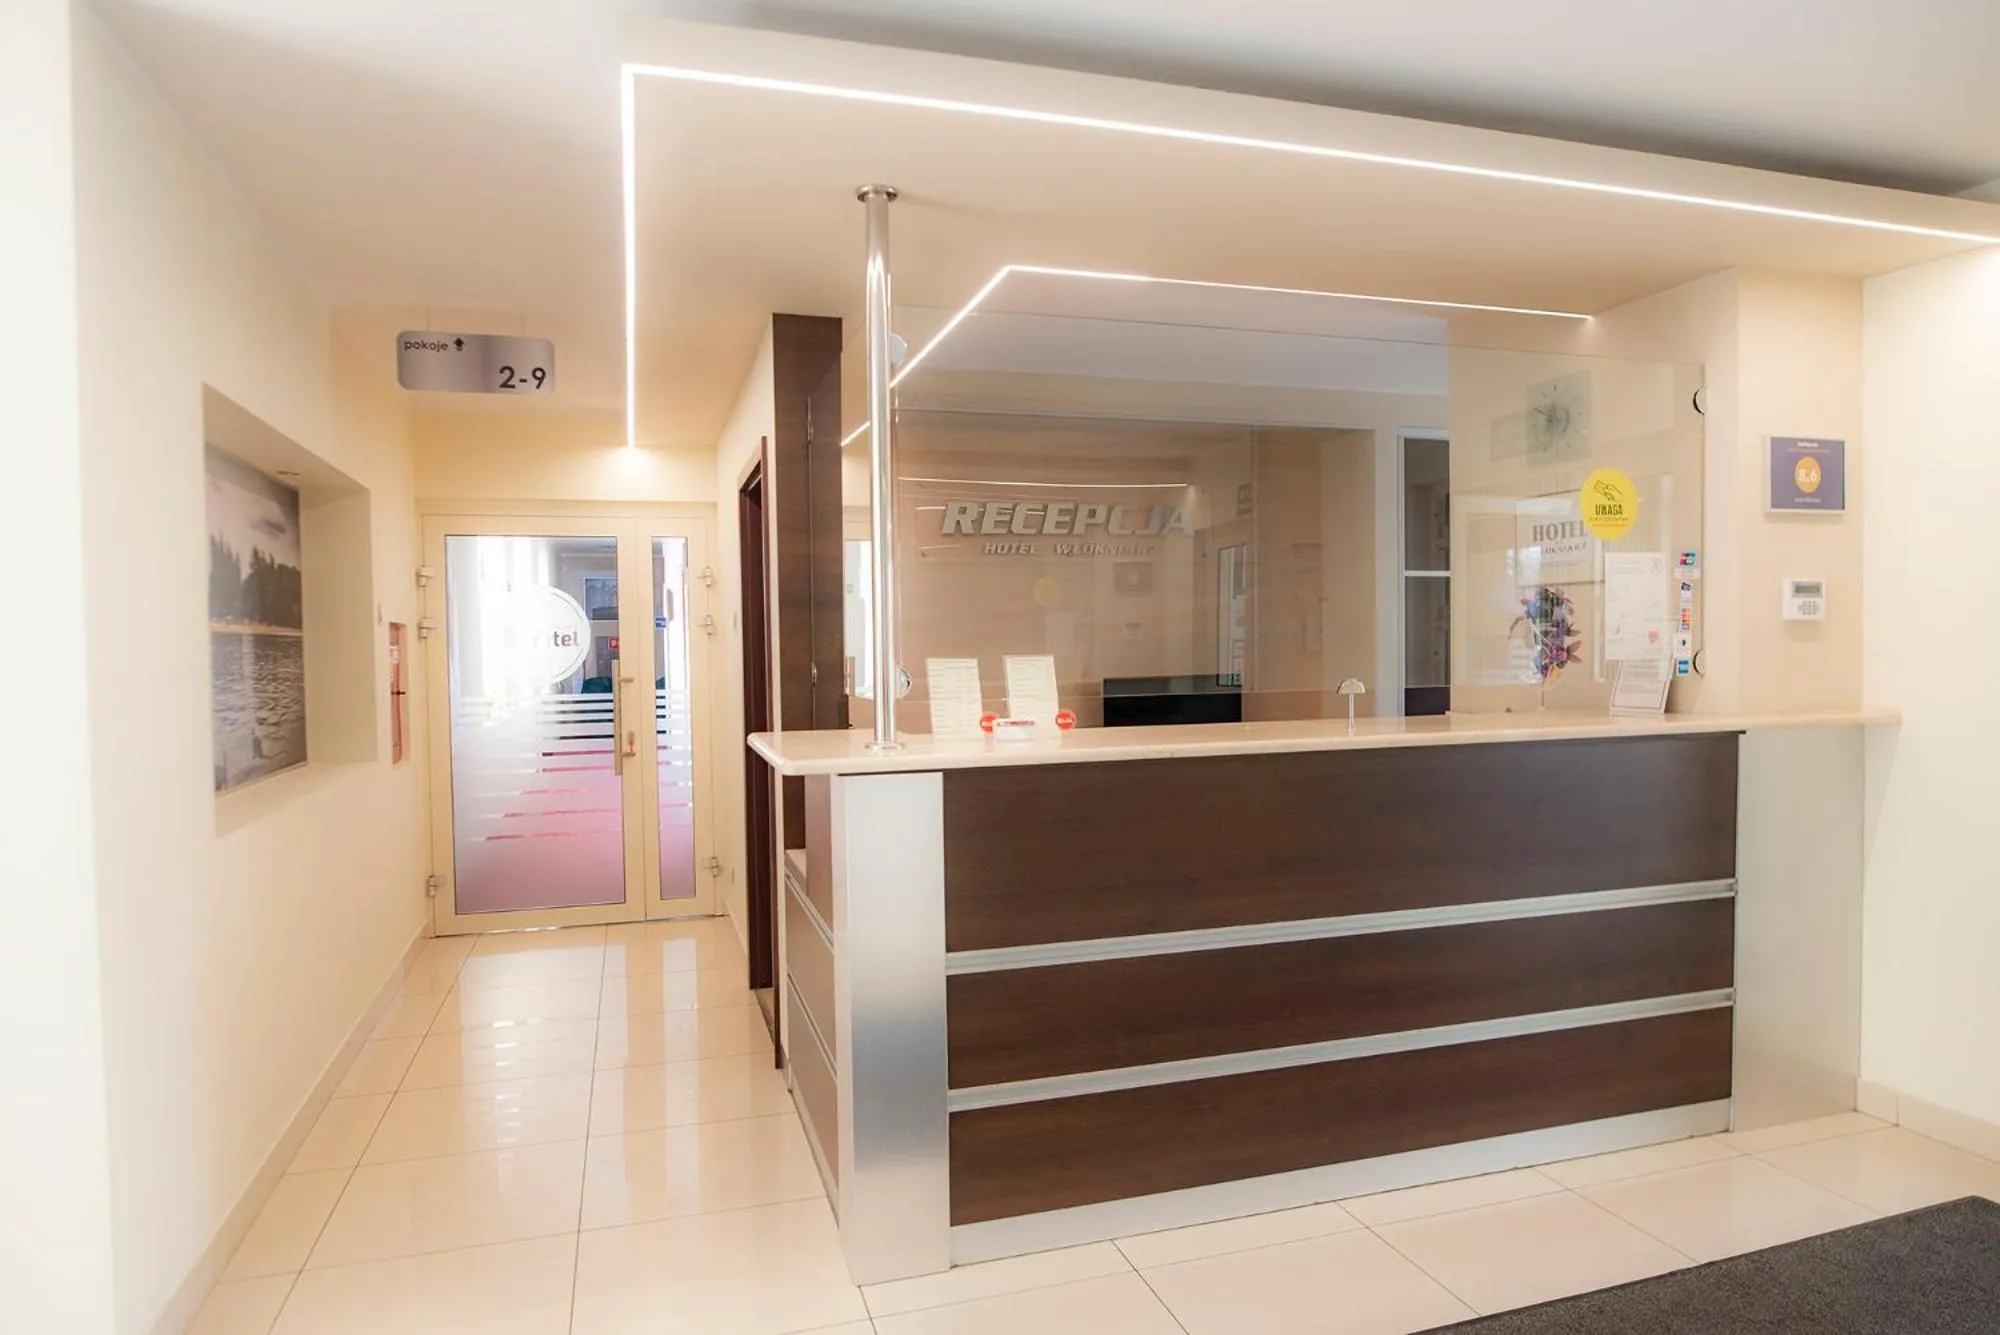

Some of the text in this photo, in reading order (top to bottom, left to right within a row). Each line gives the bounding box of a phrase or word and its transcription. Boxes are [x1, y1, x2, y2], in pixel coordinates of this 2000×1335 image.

[404, 340, 449, 352] pokoje
[499, 366, 546, 389] 2-9
[941, 501, 1194, 535] RECEPCJA
[1595, 503, 1623, 516] UWAGA
[1532, 520, 1588, 542] HOTEL
[984, 541, 1037, 555] HOTEL
